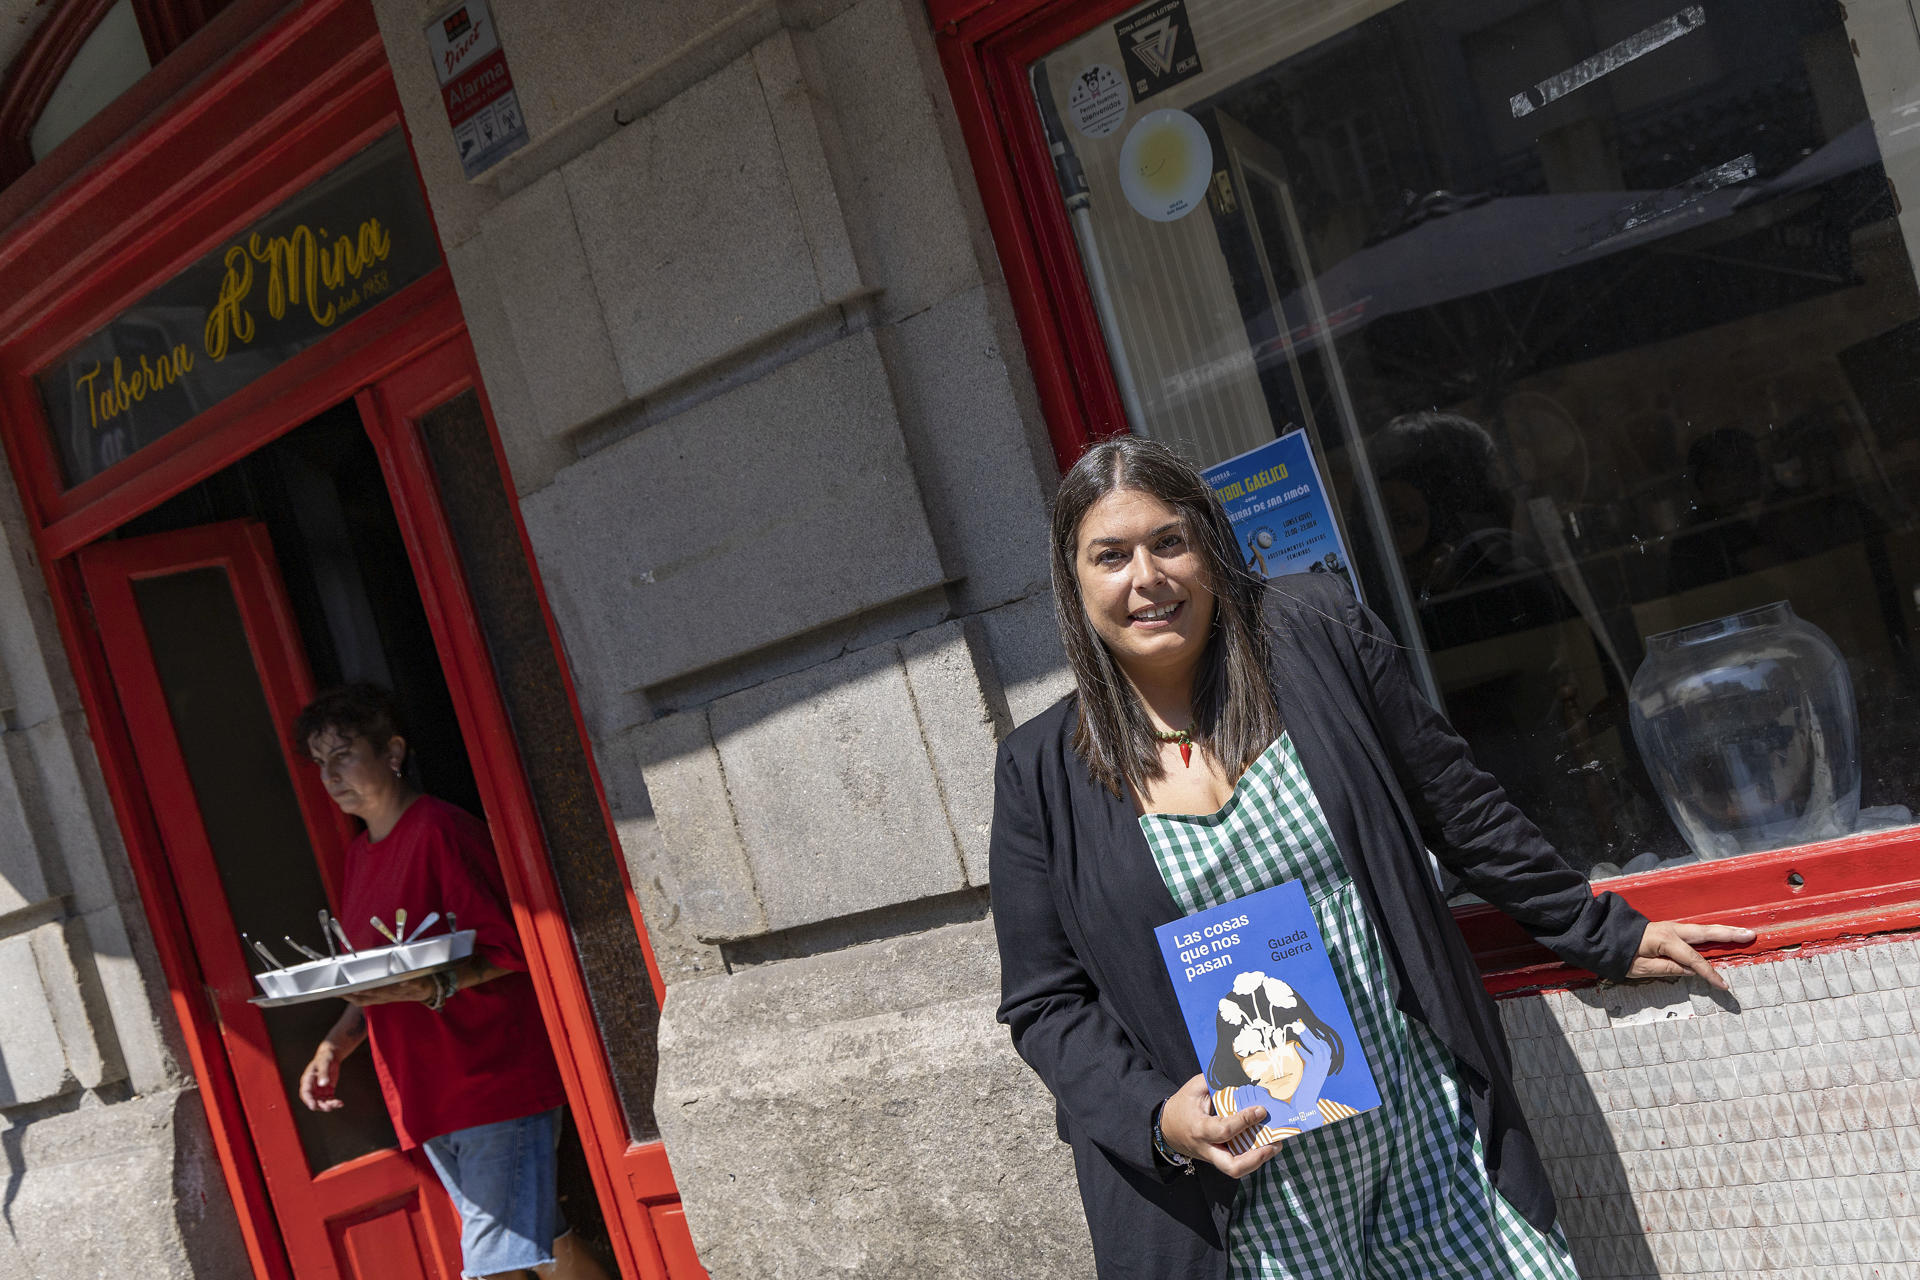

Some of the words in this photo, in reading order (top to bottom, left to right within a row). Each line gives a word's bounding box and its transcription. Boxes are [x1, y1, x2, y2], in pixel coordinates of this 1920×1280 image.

[445, 20, 482, 74] Direct
[451, 63, 504, 109] Alarma
[77, 343, 194, 428] Taberna
[204, 245, 255, 362] A
[249, 217, 390, 326] Mina
[1244, 463, 1288, 493] GAÉLICO
[1229, 507, 1252, 522] EIRAS
[1253, 502, 1266, 513] DE
[1266, 495, 1283, 509] SAN
[1284, 483, 1310, 503] SIMÓN
[1174, 930, 1202, 949] Las
[1203, 914, 1249, 938] cosas
[1268, 929, 1308, 949] Guada
[1180, 944, 1210, 964] que
[1211, 933, 1240, 952] nos
[1271, 942, 1312, 962] Guerra
[1184, 953, 1233, 983] pasan
